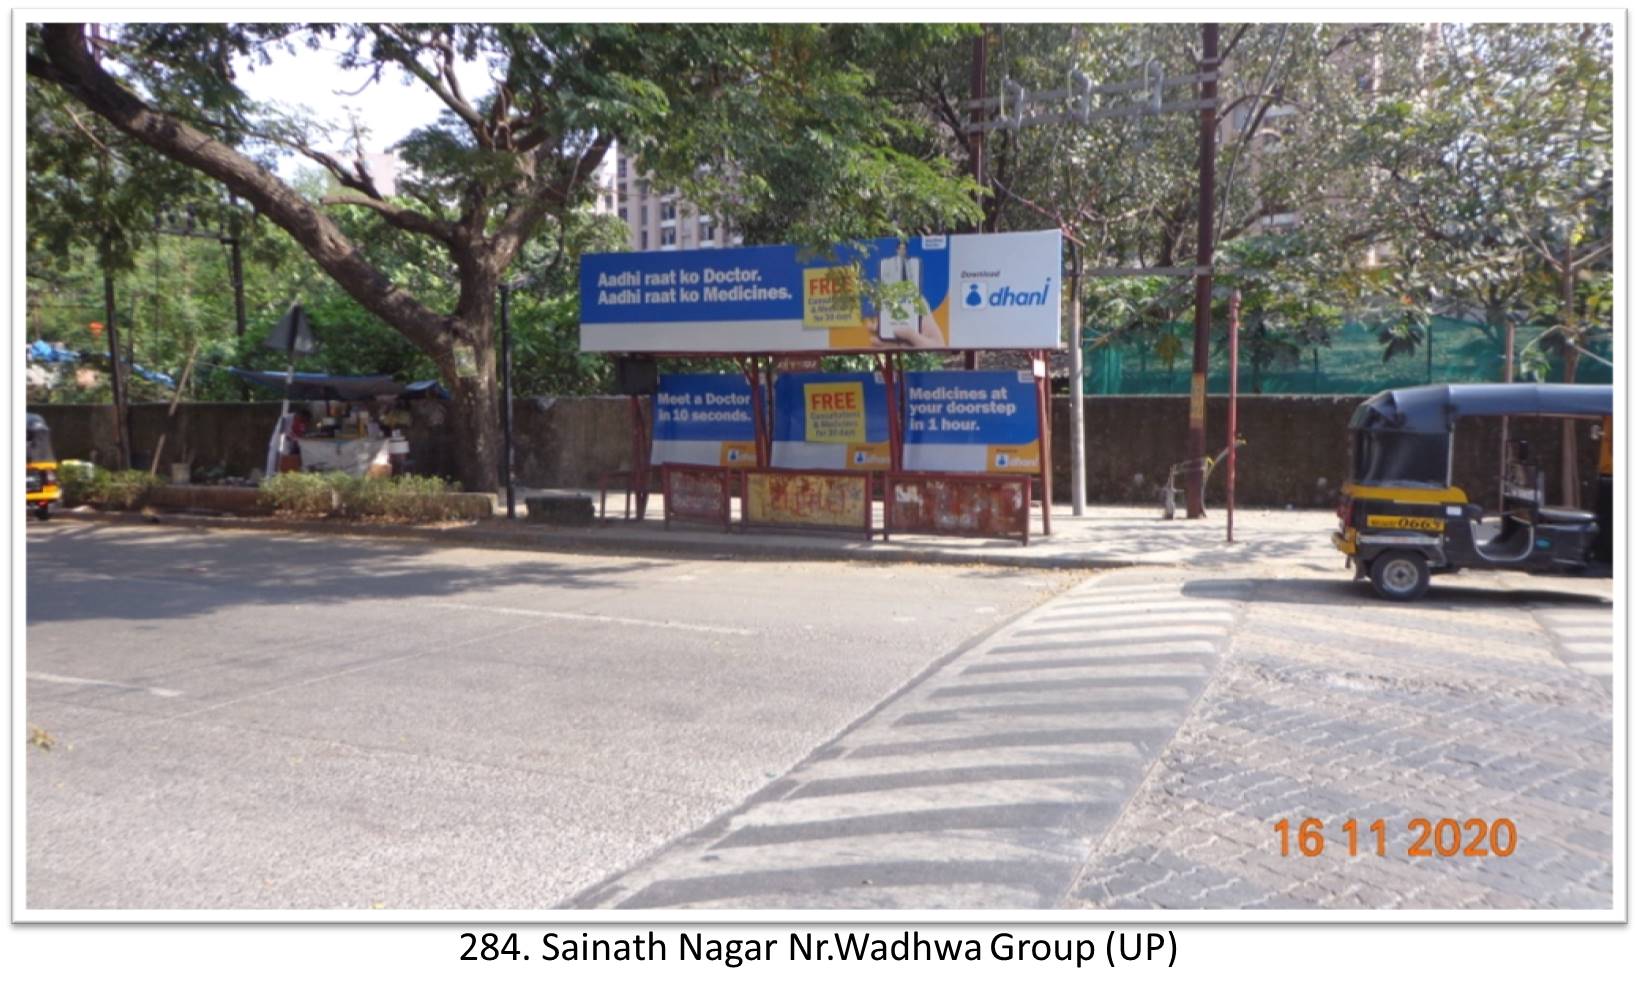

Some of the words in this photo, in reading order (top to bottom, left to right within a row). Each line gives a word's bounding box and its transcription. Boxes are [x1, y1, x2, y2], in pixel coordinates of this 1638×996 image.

[598, 271, 640, 288] Aadhi
[645, 270, 676, 286] raat
[679, 269, 699, 285] ko
[703, 267, 762, 284] Doctor.
[598, 289, 640, 305] Aadhi
[645, 288, 676, 304] raat
[679, 287, 699, 302] ko
[703, 284, 792, 302] Medicines.
[989, 276, 1052, 307] dhani
[657, 392, 691, 405] Meet
[694, 394, 703, 405] a
[705, 392, 751, 405] Doctor
[811, 392, 857, 411] FREE
[909, 386, 988, 401] Medicines
[991, 386, 1008, 400] at
[658, 408, 671, 421] in
[673, 408, 689, 421] 10
[692, 409, 752, 422] seconds.
[909, 402, 943, 417] your
[946, 401, 1017, 417] doorstep
[910, 417, 925, 431] in
[927, 417, 938, 431] 1
[941, 417, 981, 431] hour.
